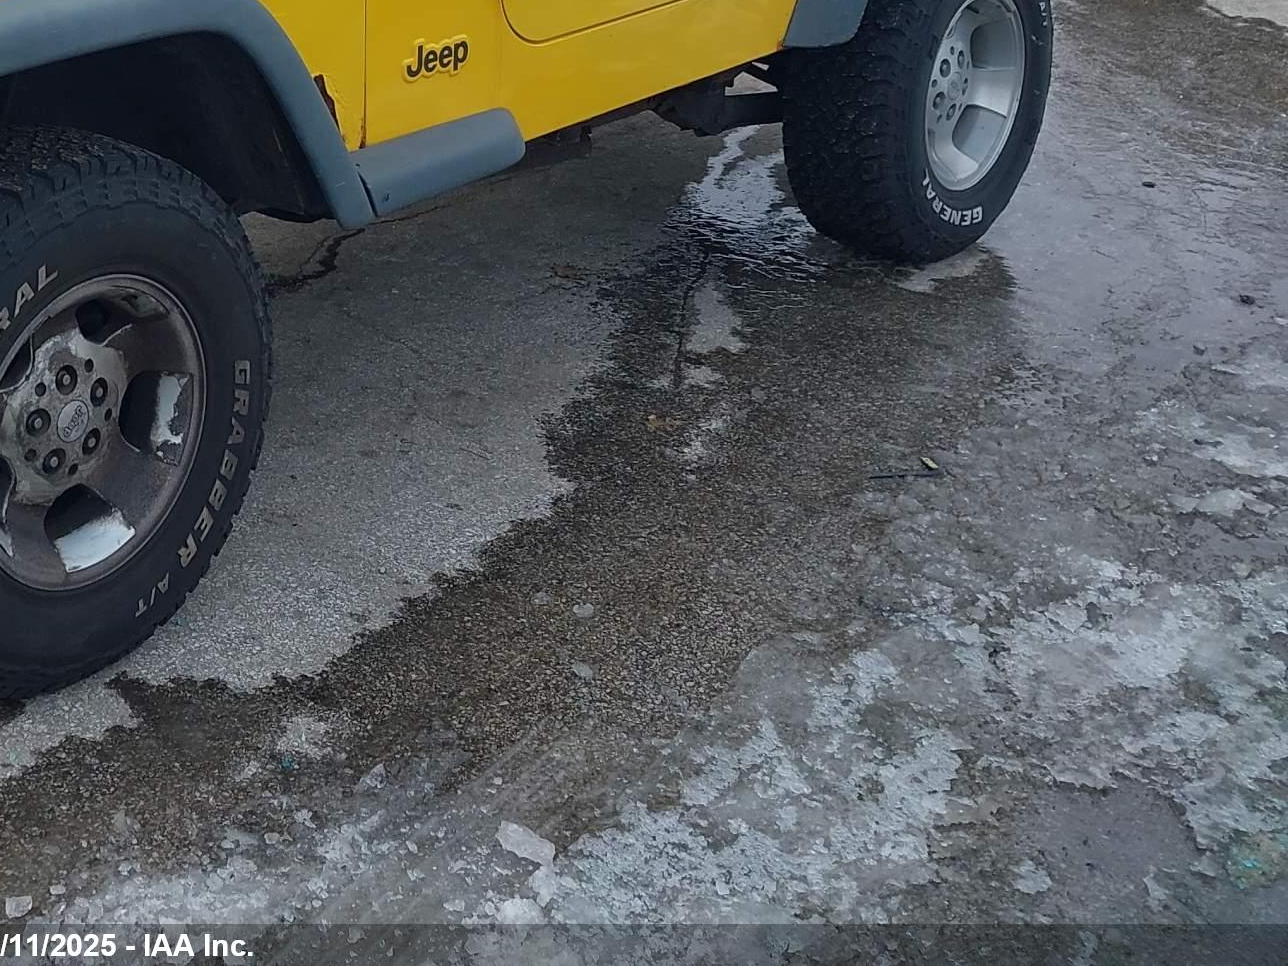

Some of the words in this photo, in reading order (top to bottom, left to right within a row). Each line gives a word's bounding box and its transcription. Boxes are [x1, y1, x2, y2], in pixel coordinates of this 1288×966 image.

[406, 40, 469, 78] Jeep
[922, 167, 983, 226] GENERAL
[177, 360, 251, 568] GRABBER
[135, 572, 170, 618] A/T
